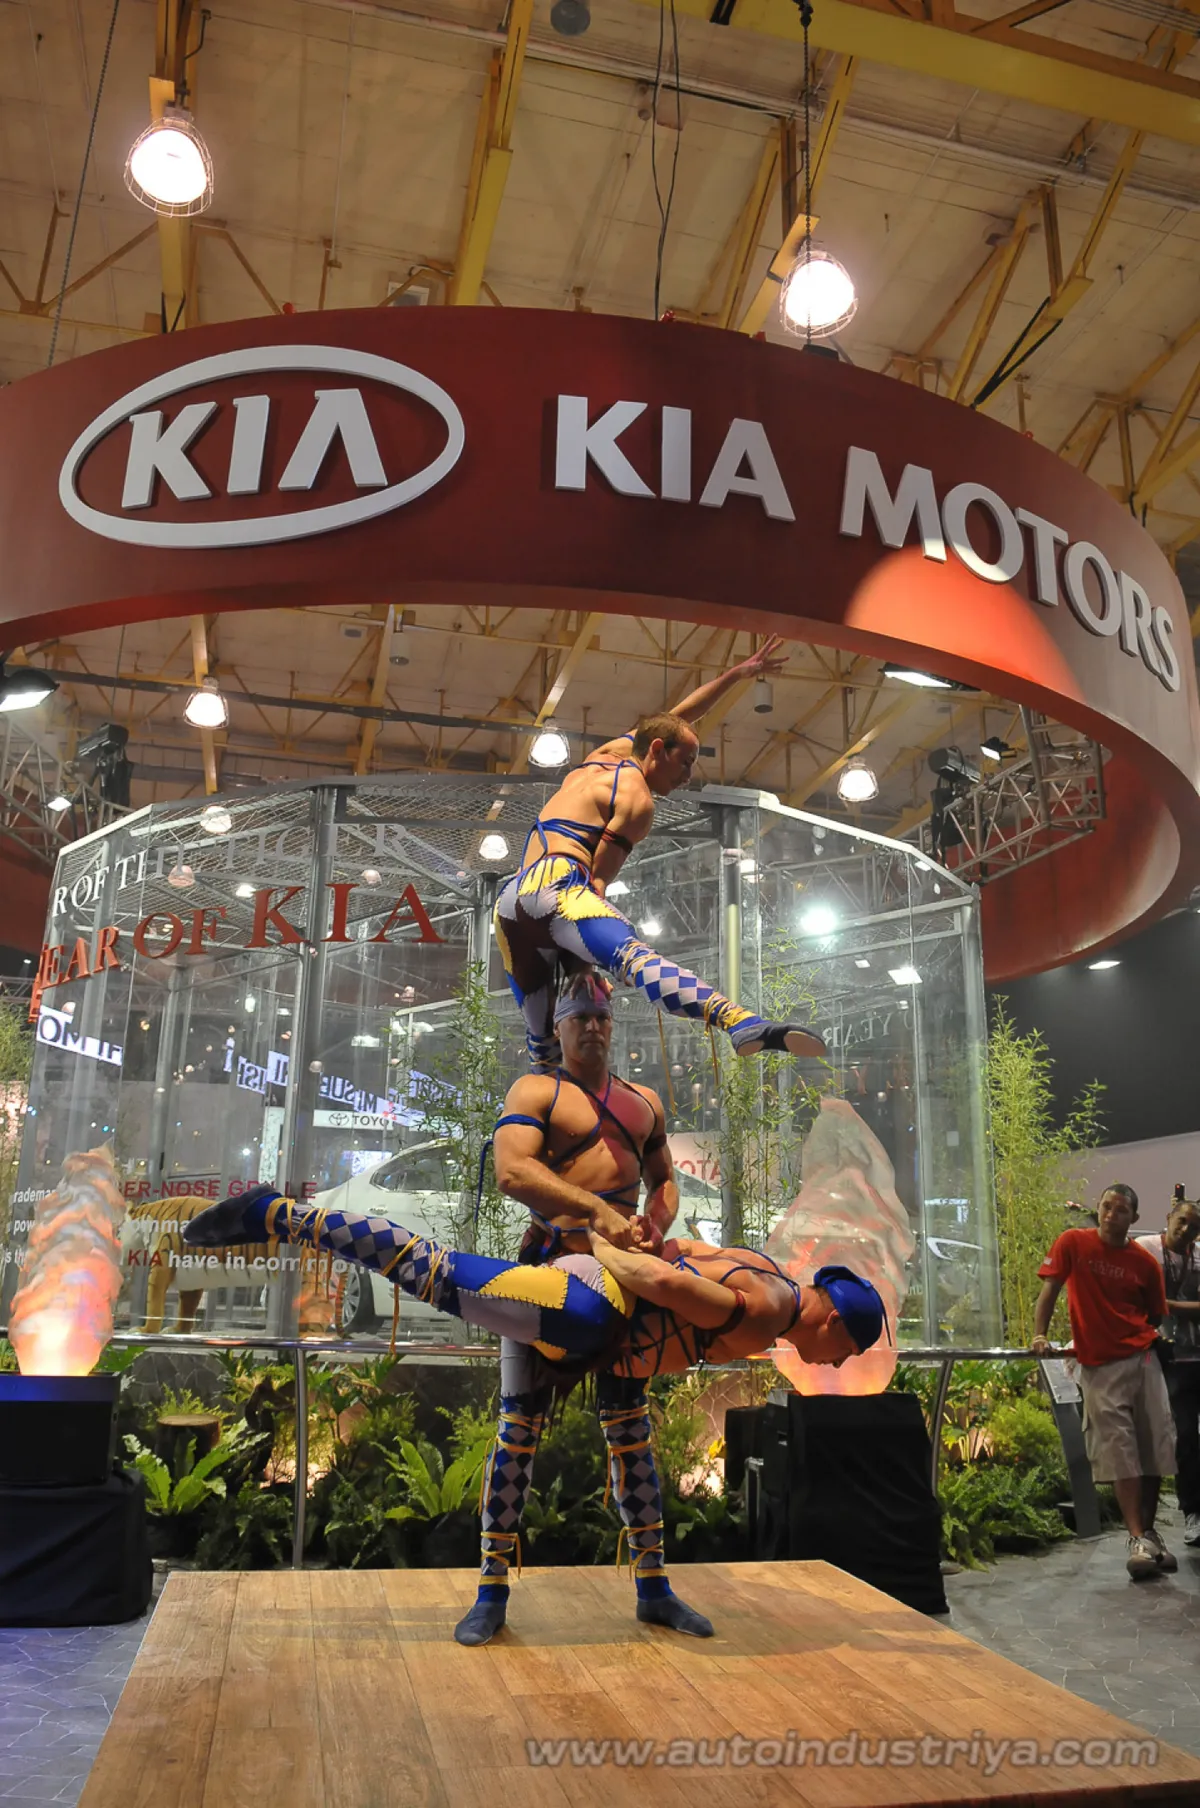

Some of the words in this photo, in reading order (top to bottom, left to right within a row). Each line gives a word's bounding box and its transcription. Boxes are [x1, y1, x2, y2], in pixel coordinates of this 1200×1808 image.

[121, 388, 388, 510] KIA
[555, 394, 796, 522] KIA
[839, 446, 1180, 693] MOTORS
[71, 866, 110, 909] OF
[133, 906, 228, 960] OF
[243, 883, 447, 949] KIA
[119, 1180, 221, 1198] ER-NOSE
[128, 1249, 162, 1266] KIA
[168, 1250, 218, 1269] have
[226, 1252, 245, 1270] in
